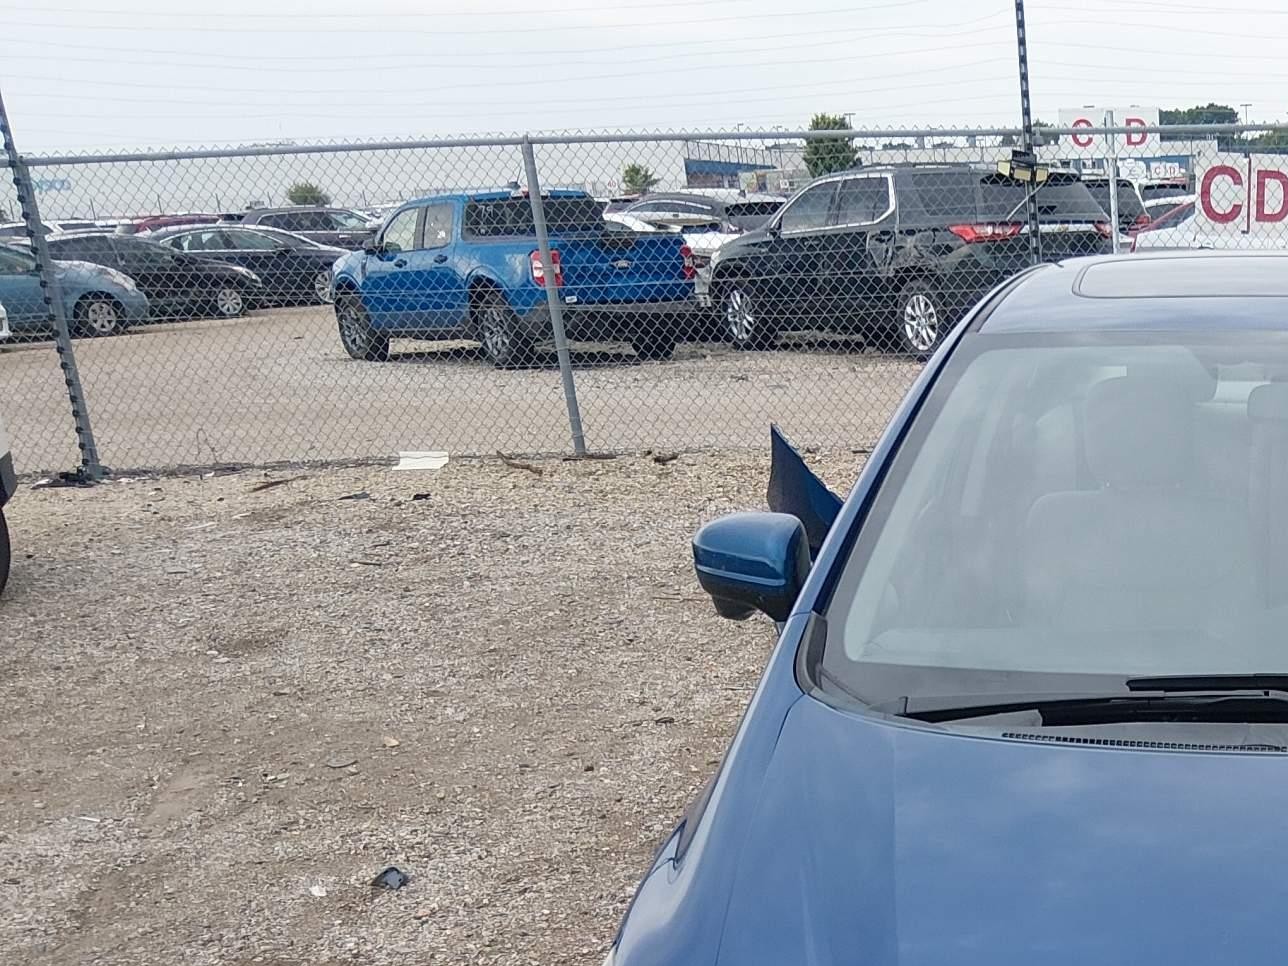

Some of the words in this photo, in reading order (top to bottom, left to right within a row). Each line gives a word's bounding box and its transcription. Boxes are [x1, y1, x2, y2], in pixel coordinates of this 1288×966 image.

[1072, 119, 1093, 147] C
[1125, 118, 1147, 146] D
[1200, 165, 1243, 224] C
